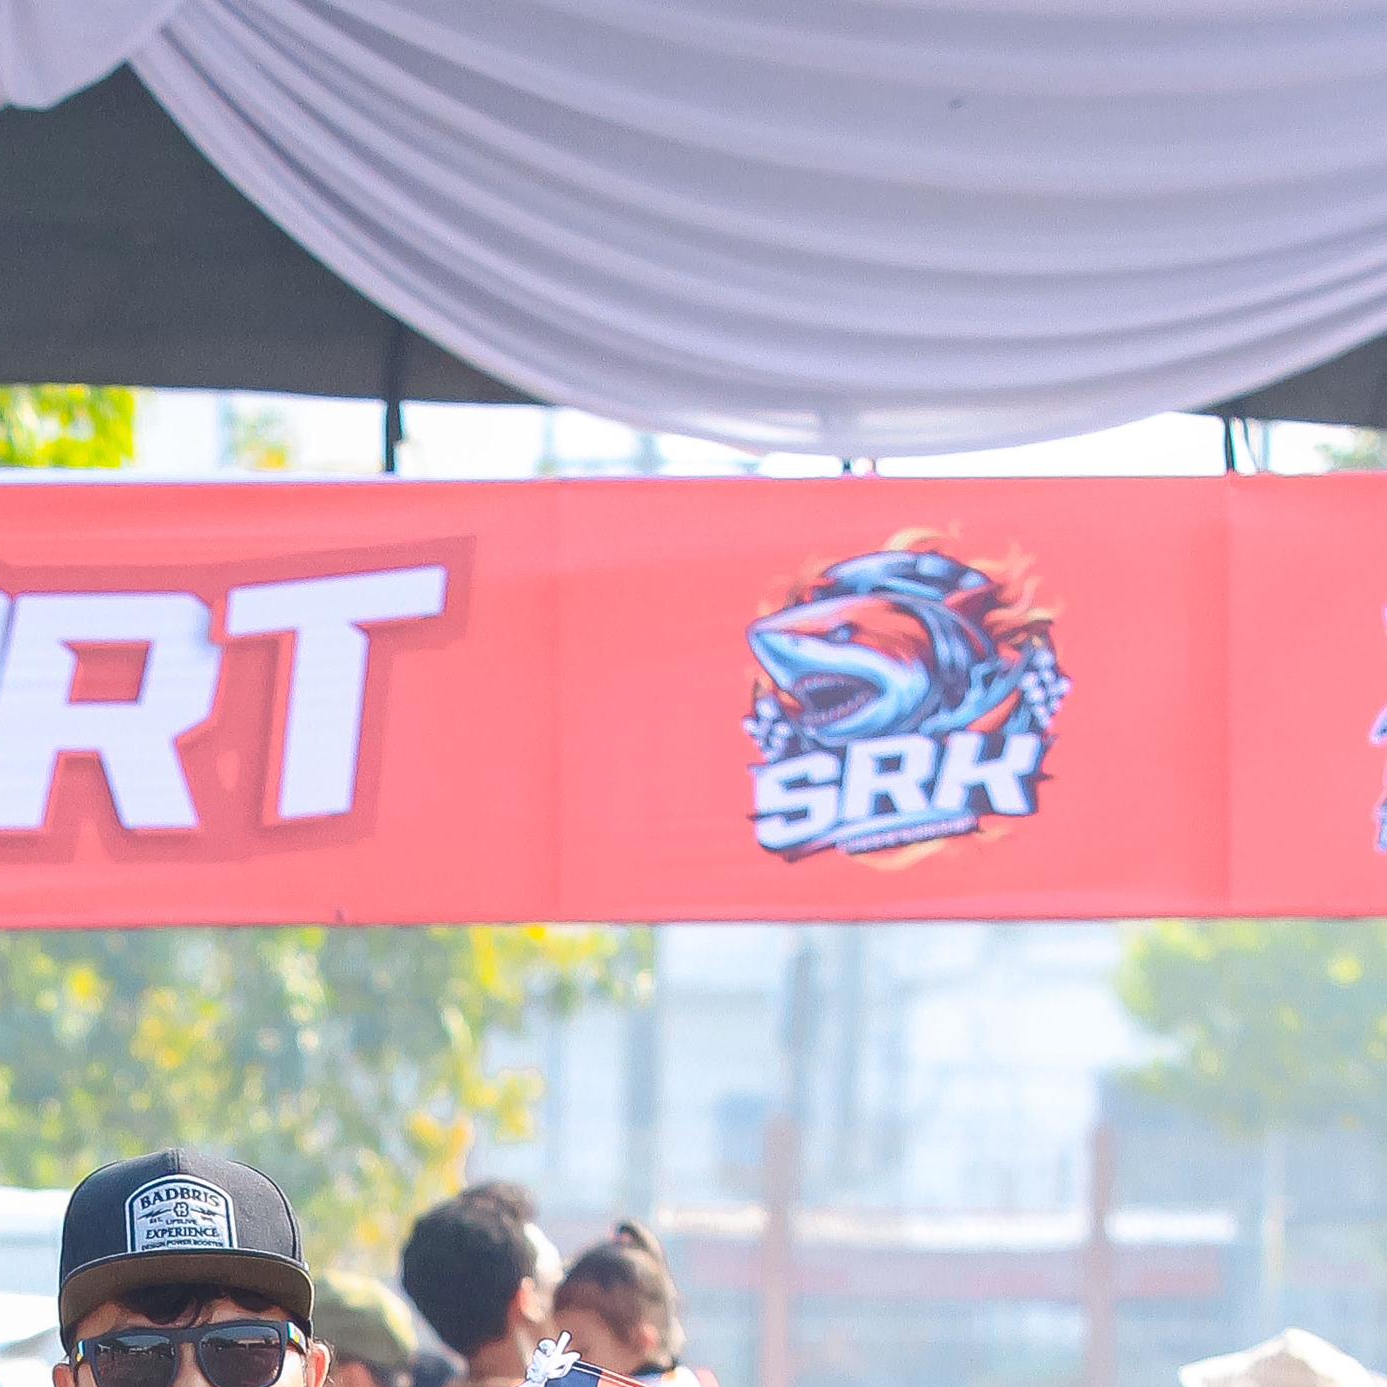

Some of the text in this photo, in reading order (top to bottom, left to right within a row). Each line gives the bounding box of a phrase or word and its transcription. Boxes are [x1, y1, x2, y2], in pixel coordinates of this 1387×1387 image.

[756, 732, 1040, 851] SRK
[139, 1187, 220, 1210] BADBRIS
[146, 1226, 219, 1239] EXPERIENCE
